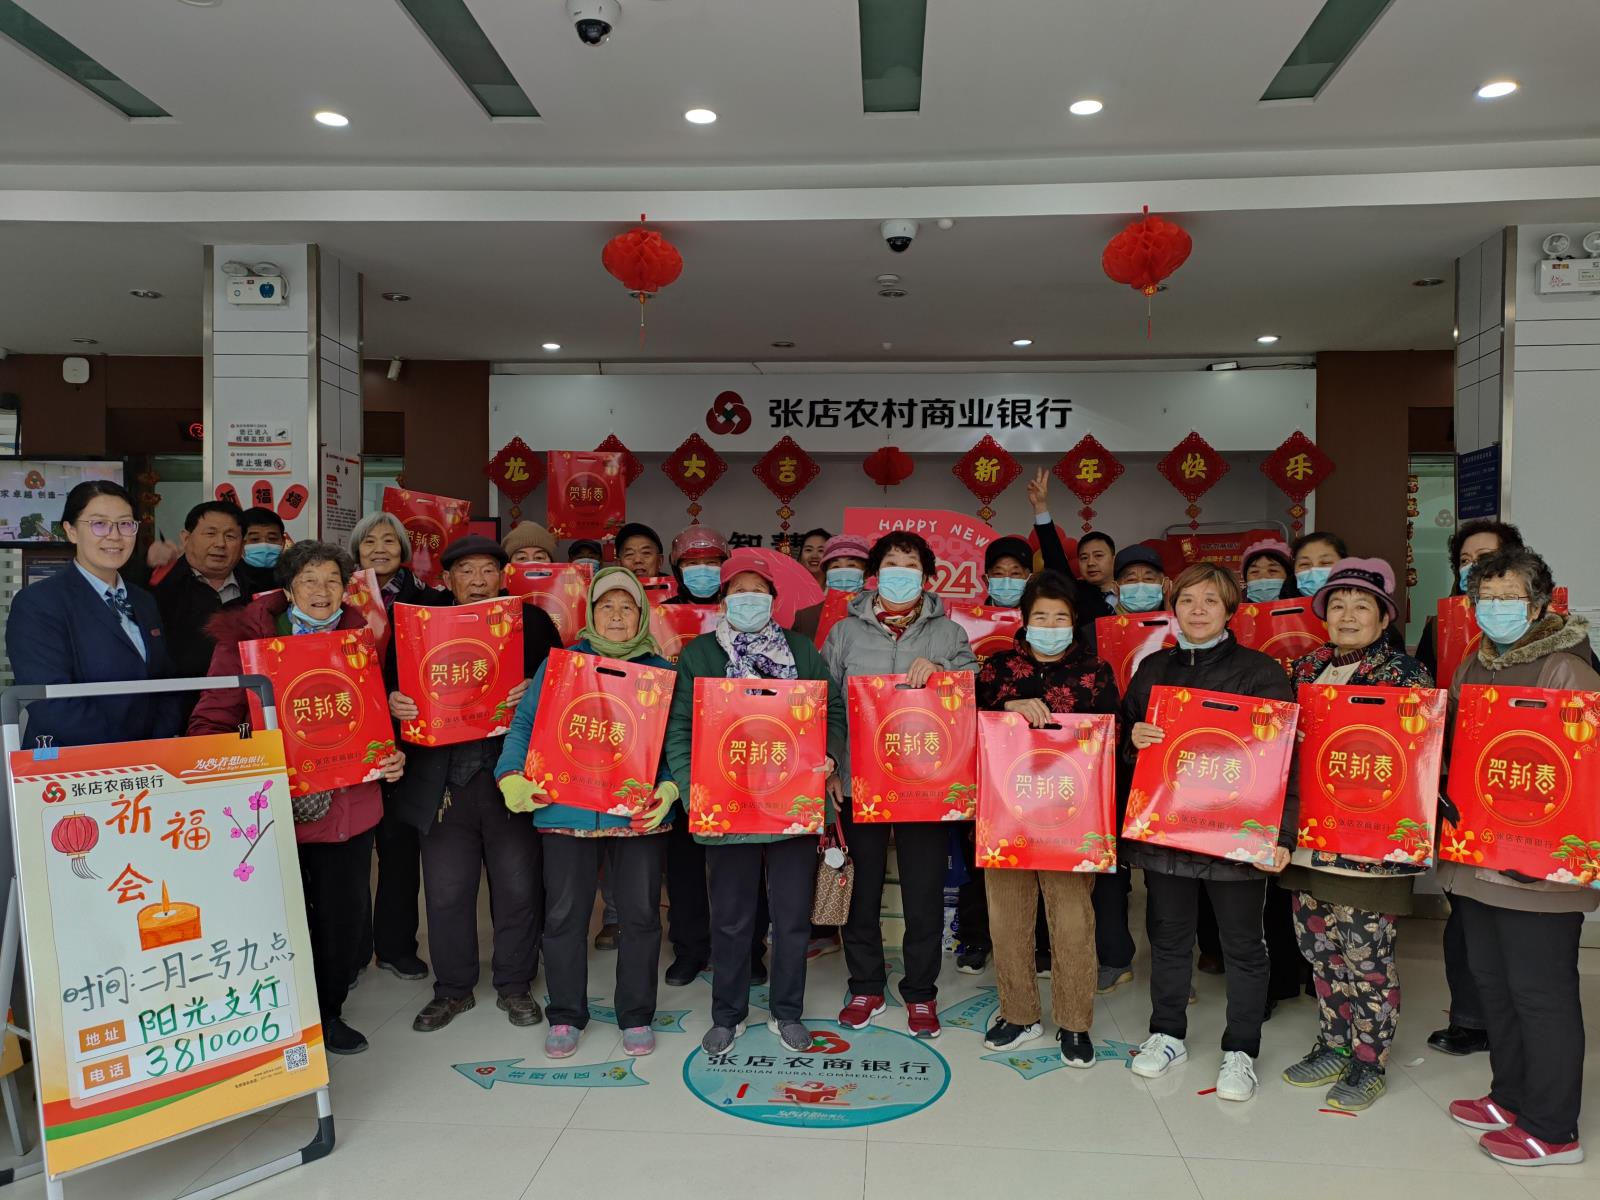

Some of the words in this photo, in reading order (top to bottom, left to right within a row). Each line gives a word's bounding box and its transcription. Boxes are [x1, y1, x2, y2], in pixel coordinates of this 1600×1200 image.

[769, 397, 1073, 430] 张店农村商业银行
[235, 458, 273, 468] 禁止吸烟
[503, 456, 530, 482] 龙
[682, 455, 707, 479] 大
[777, 456, 797, 483] 吉
[973, 456, 1001, 483] 新
[1075, 457, 1102, 483] 年
[1181, 454, 1207, 481] 快
[1286, 453, 1313, 481] 乐
[569, 486, 604, 502] 贺新春
[878, 518, 938, 533] HAPPY
[950, 523, 990, 548] NEW
[430, 658, 489, 687] 贺新春
[292, 690, 353, 725] 贺新春
[567, 712, 628, 747] 贺新春
[884, 730, 941, 757] 贺新春
[729, 739, 788, 767] 贺新春
[1175, 749, 1244, 785] 贺新春
[1327, 749, 1395, 784] 贺新春
[72, 774, 165, 797] 张店农商银行
[1014, 774, 1076, 801] 贺新春
[1487, 757, 1557, 796] 贺新春
[107, 863, 153, 905] 会
[138, 975, 282, 1044] 阳光支行
[85, 1025, 121, 1047] 地址
[145, 1011, 281, 1078] 3810006
[88, 1062, 126, 1083] 电话
[708, 1053, 932, 1074] 张店农商银行
